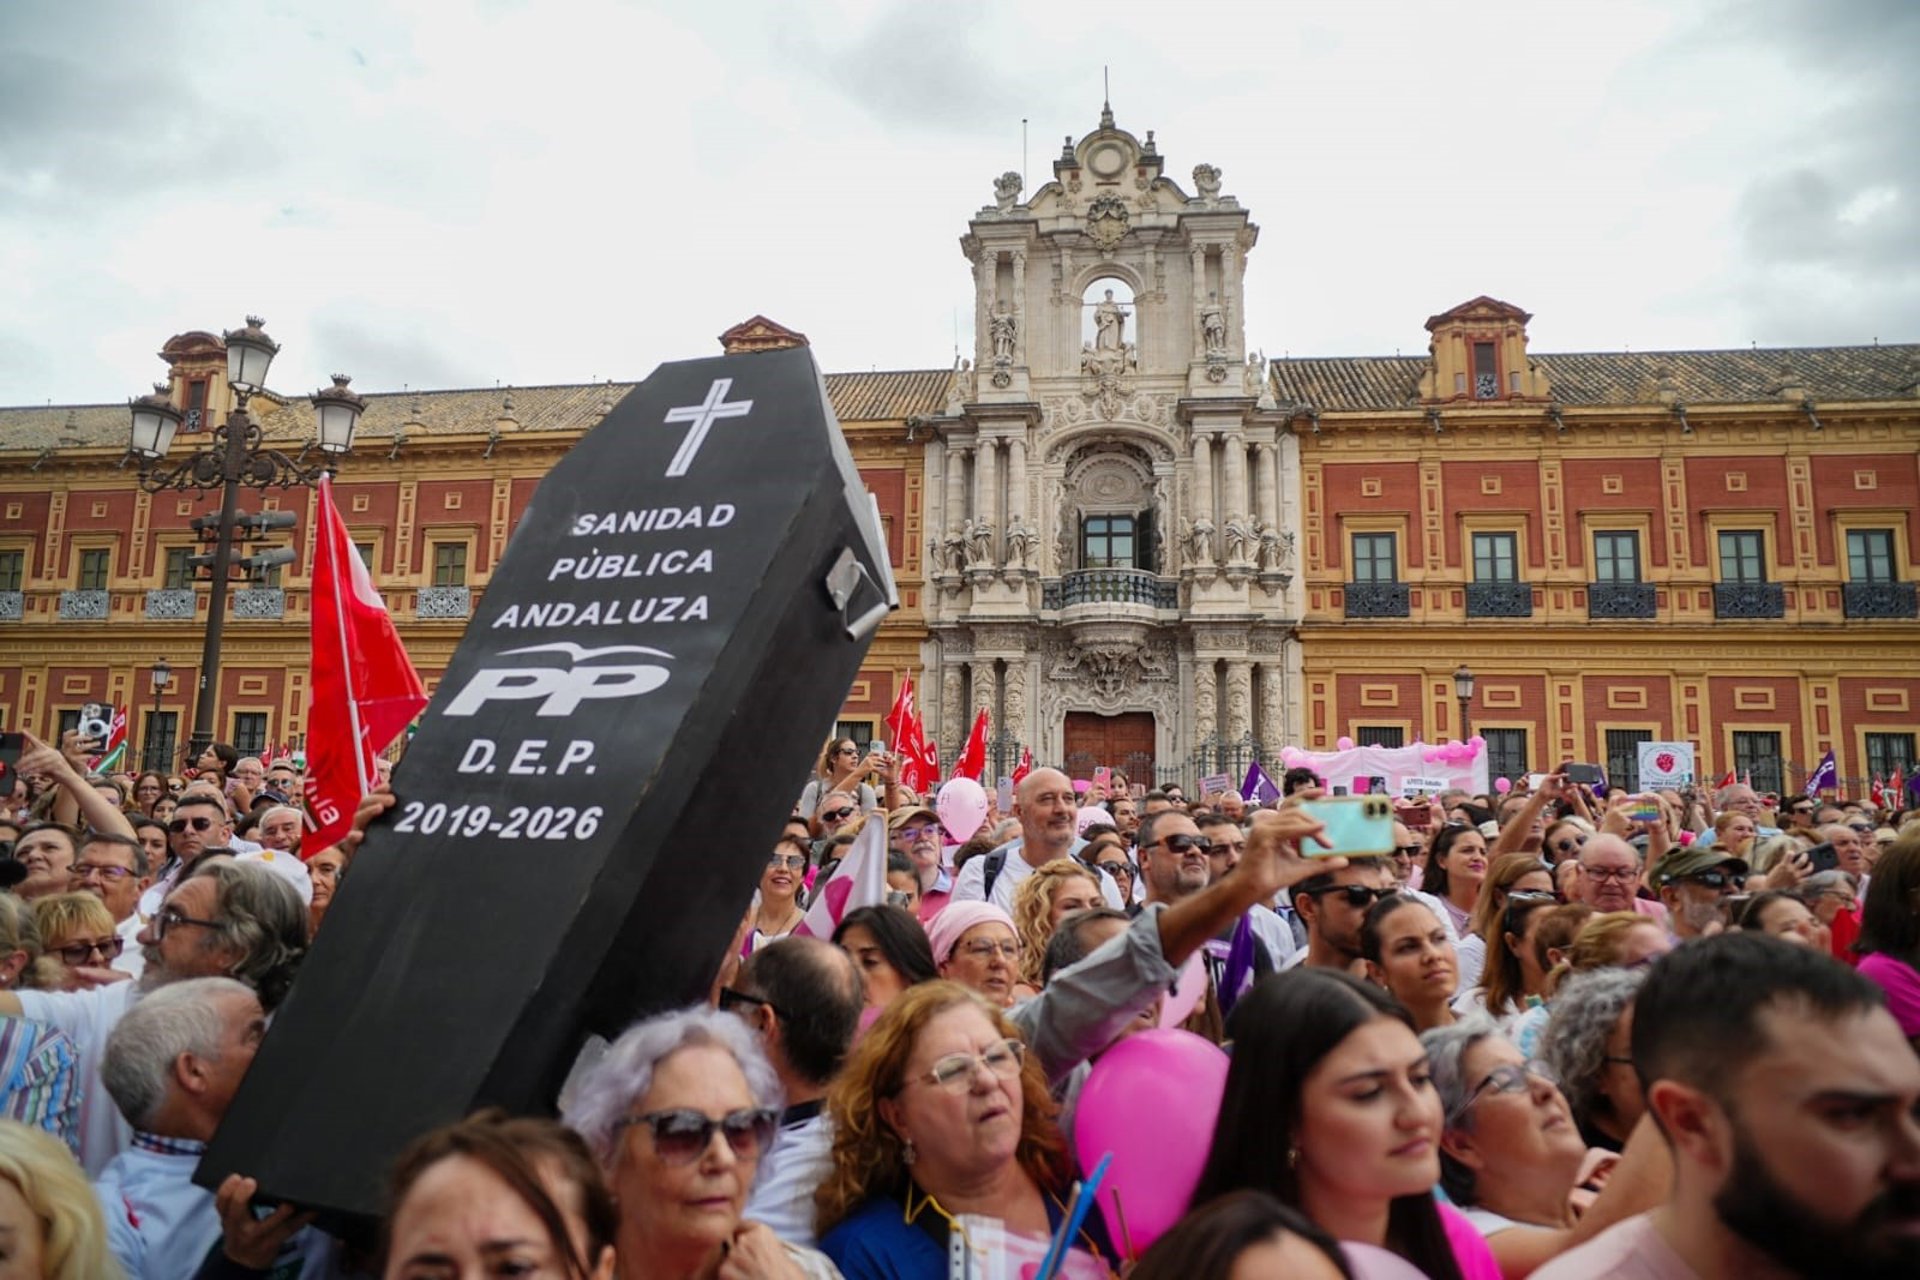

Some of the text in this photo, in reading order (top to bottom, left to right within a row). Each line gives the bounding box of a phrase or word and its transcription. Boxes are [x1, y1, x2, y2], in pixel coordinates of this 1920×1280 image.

[572, 503, 736, 536] SANIDAD
[491, 595, 708, 629] ANDALUZA
[442, 664, 671, 717] PP
[393, 801, 603, 840] 2019-2026
